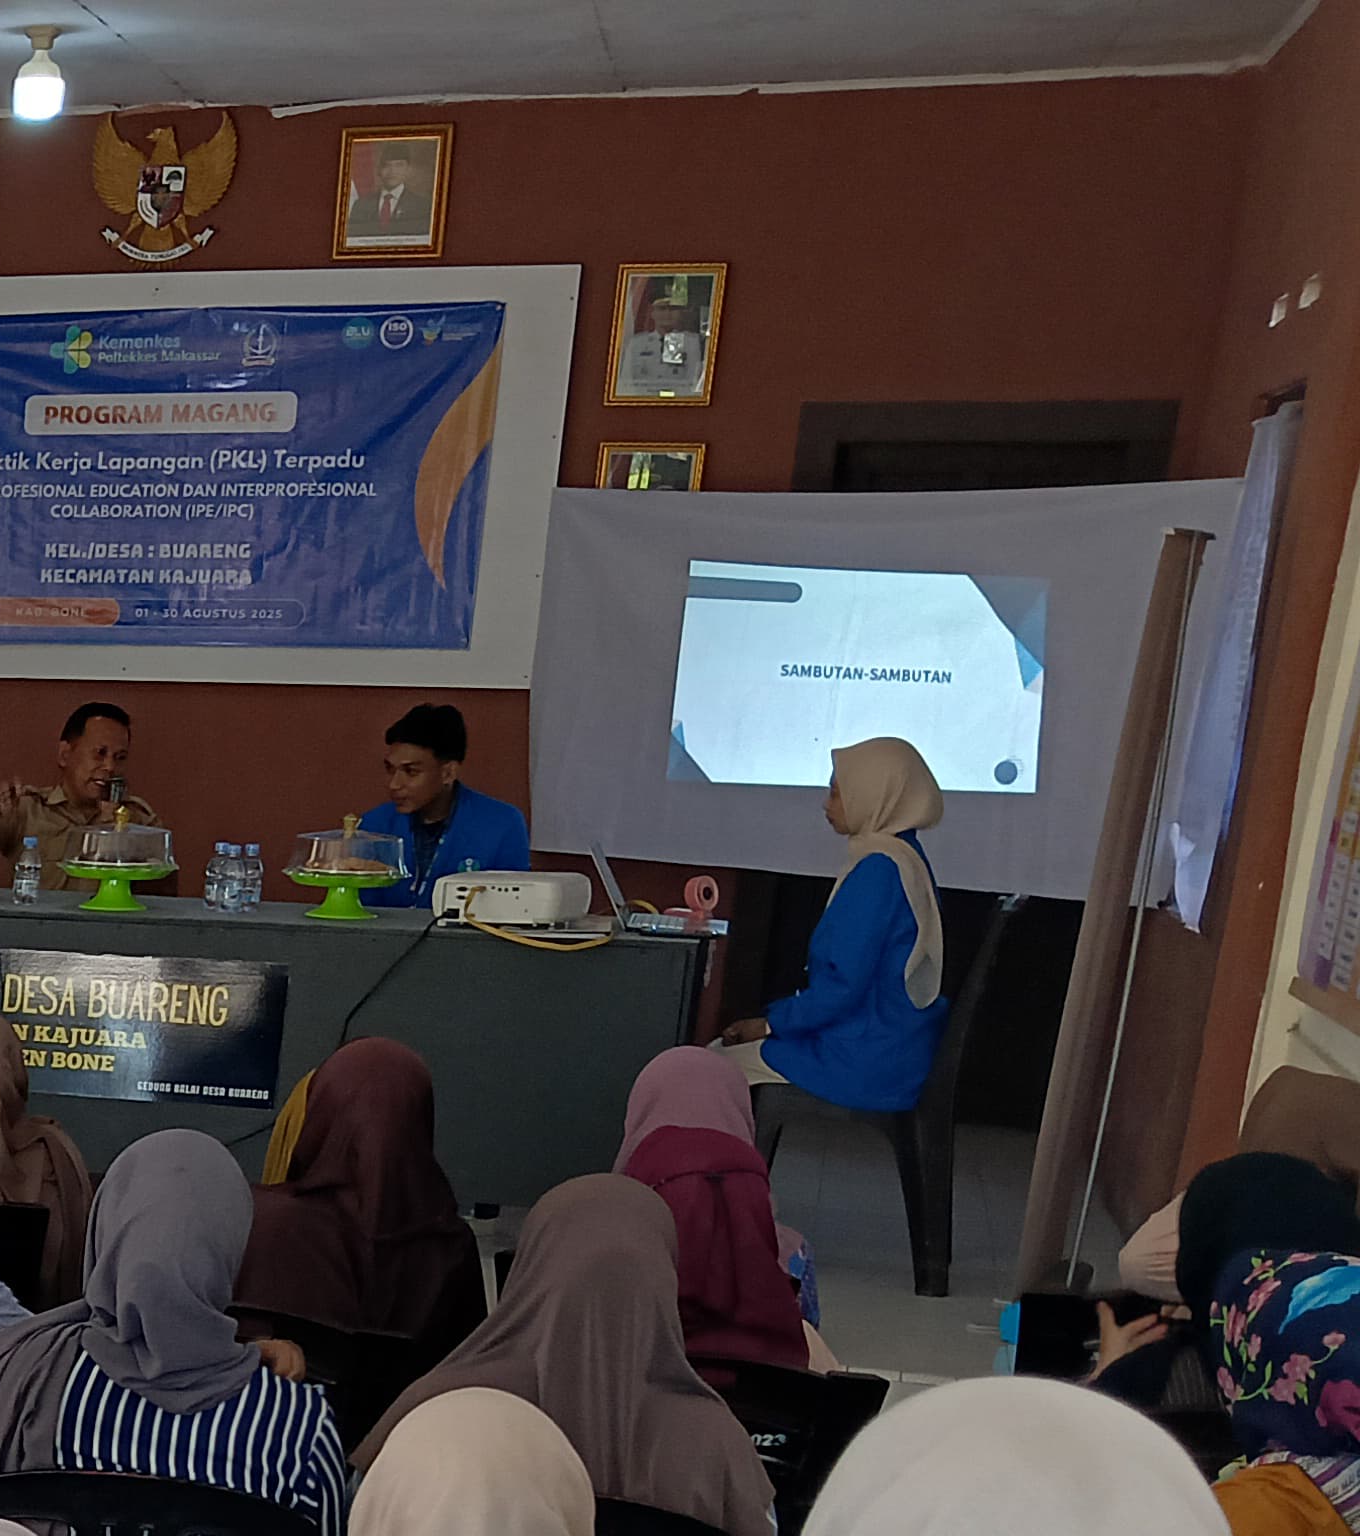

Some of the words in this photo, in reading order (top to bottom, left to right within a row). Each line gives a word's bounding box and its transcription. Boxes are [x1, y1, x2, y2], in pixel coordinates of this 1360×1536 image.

[388, 322, 407, 331] ISO
[98, 335, 181, 349] Kemenkes
[44, 404, 164, 425] PROGRAM
[171, 402, 277, 423] MAGANG
[36, 451, 92, 475] Kerja
[97, 450, 203, 474] Lapangan
[210, 449, 266, 473] (PKL)
[274, 448, 365, 472] Terpadu
[89, 483, 178, 498] EDUCATION
[183, 483, 217, 497] DAN
[220, 482, 377, 497] INTERPROFESIONAL
[50, 503, 181, 518] COLLABORATION
[185, 503, 254, 520] (IPE/IPC)
[44, 543, 143, 560] KEL./DESA
[159, 543, 251, 559] BUARENG
[40, 568, 154, 584] KECAMATAN
[159, 569, 252, 584] KAJUARA
[162, 608, 178, 618] 30
[183, 608, 246, 618] AGUSTUS
[251, 609, 283, 619] 2025
[780, 663, 953, 684] SAMBUTAN-SAMBUTAN
[2, 973, 76, 1017] DESA
[87, 978, 229, 1027] BUARENG
[34, 1024, 147, 1049] KAJUARA
[51, 1051, 116, 1073] BONE
[202, 1086, 226, 1097] DESA
